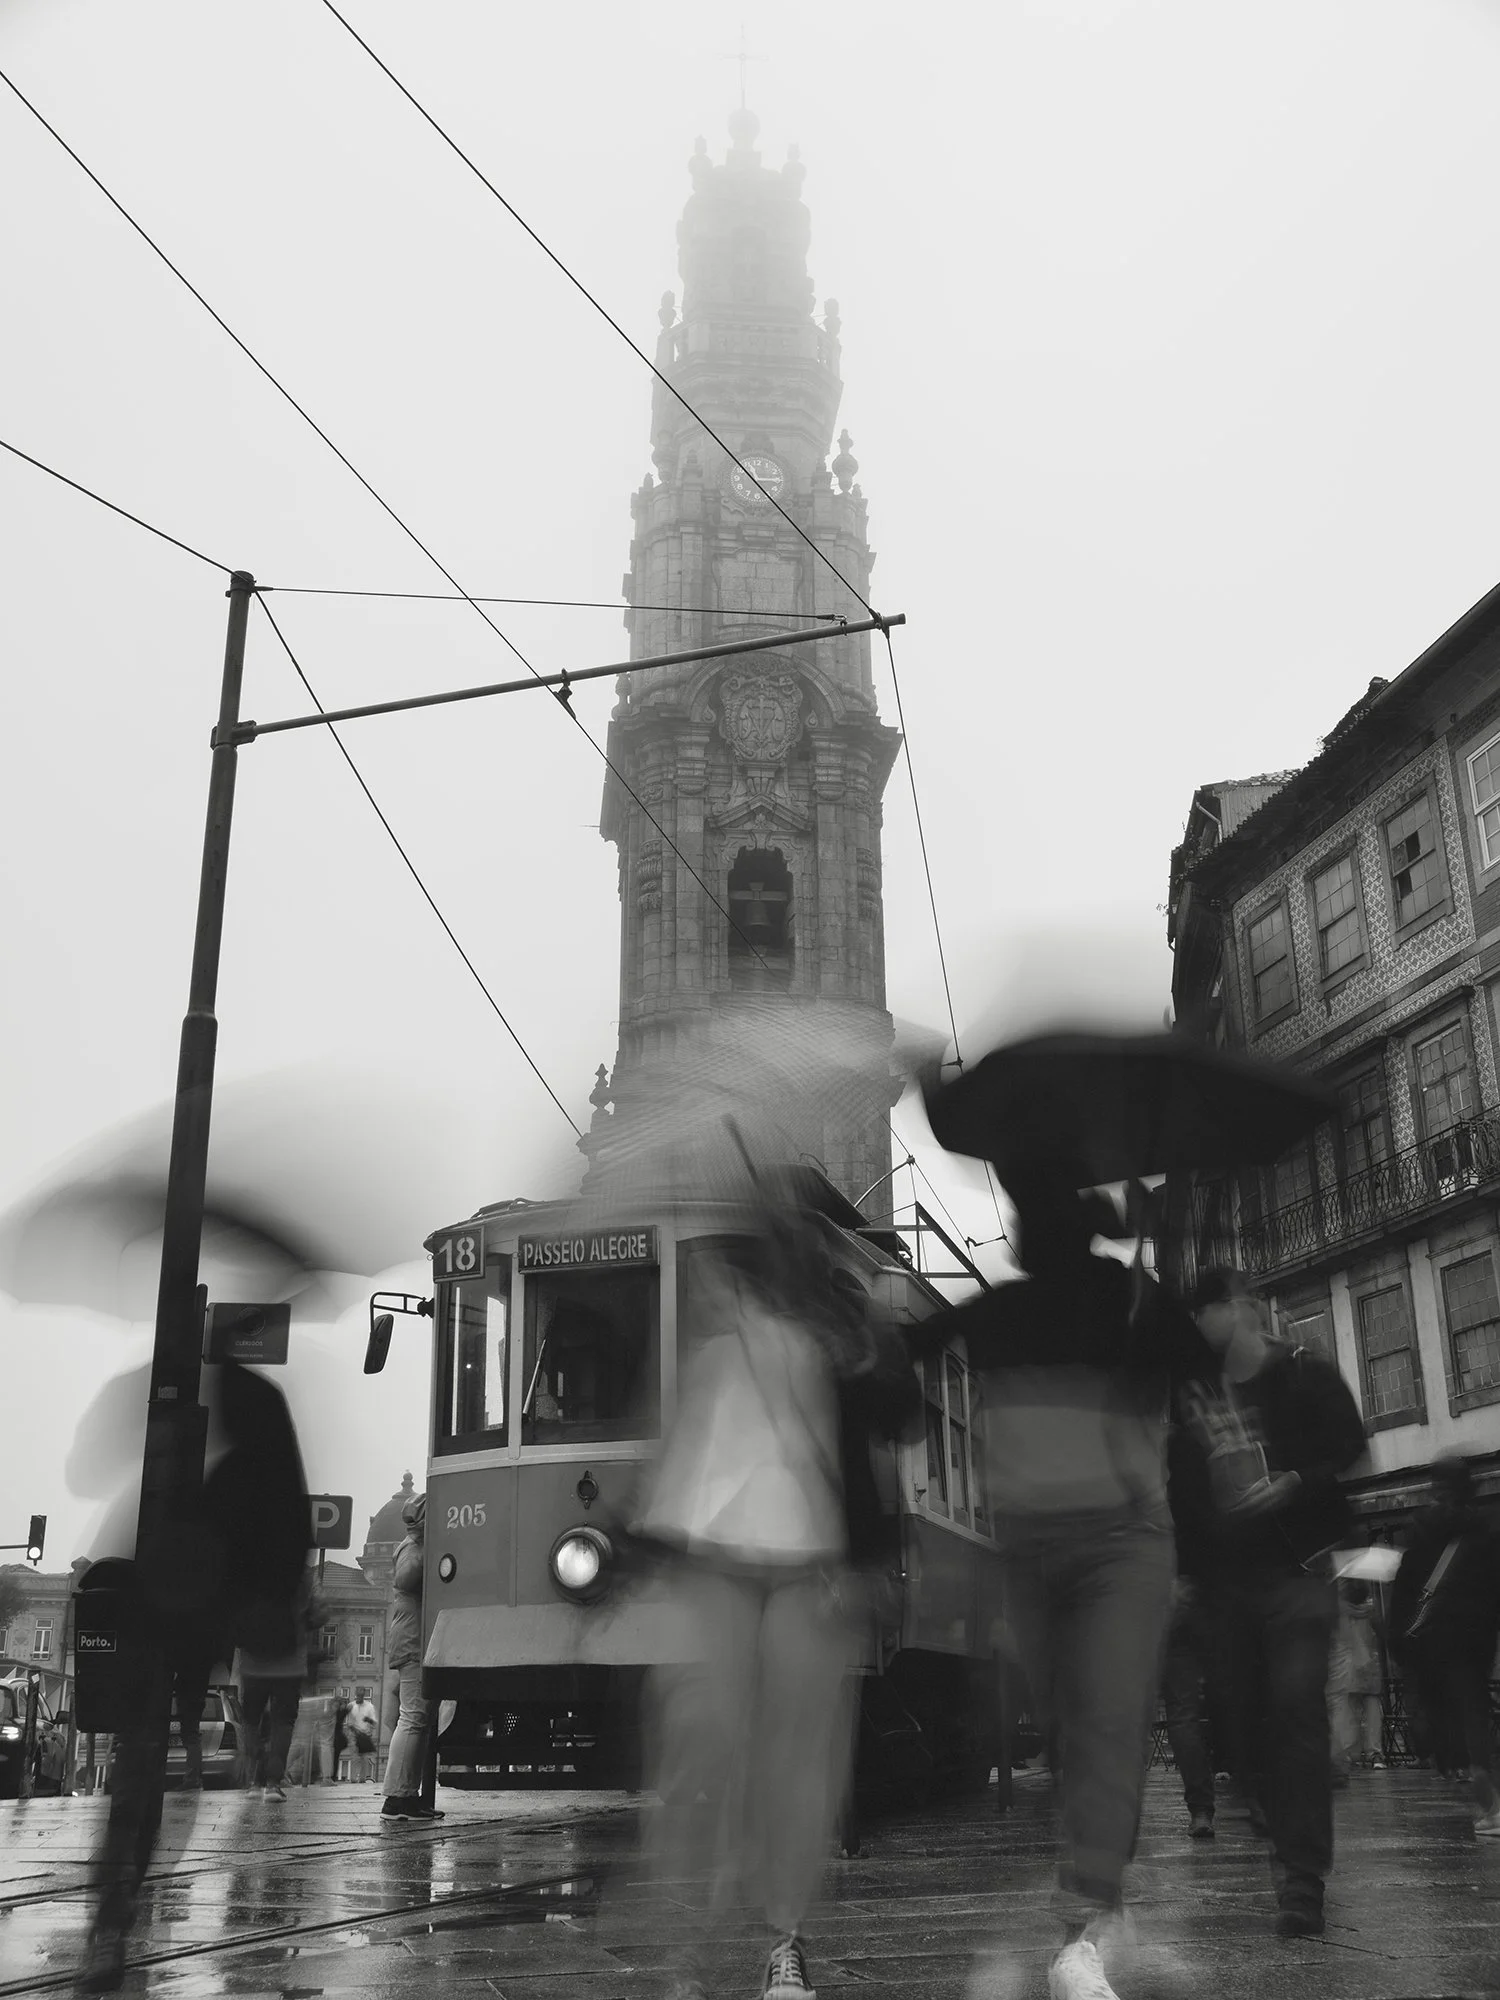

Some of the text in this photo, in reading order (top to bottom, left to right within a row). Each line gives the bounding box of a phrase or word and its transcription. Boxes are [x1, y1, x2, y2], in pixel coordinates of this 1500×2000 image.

[437, 1236, 476, 1273] 18
[523, 1234, 647, 1267] PASSEIO ALEGRE
[311, 1501, 340, 1545] P
[446, 1503, 487, 1529] 205
[80, 1635, 111, 1647] Porto.
